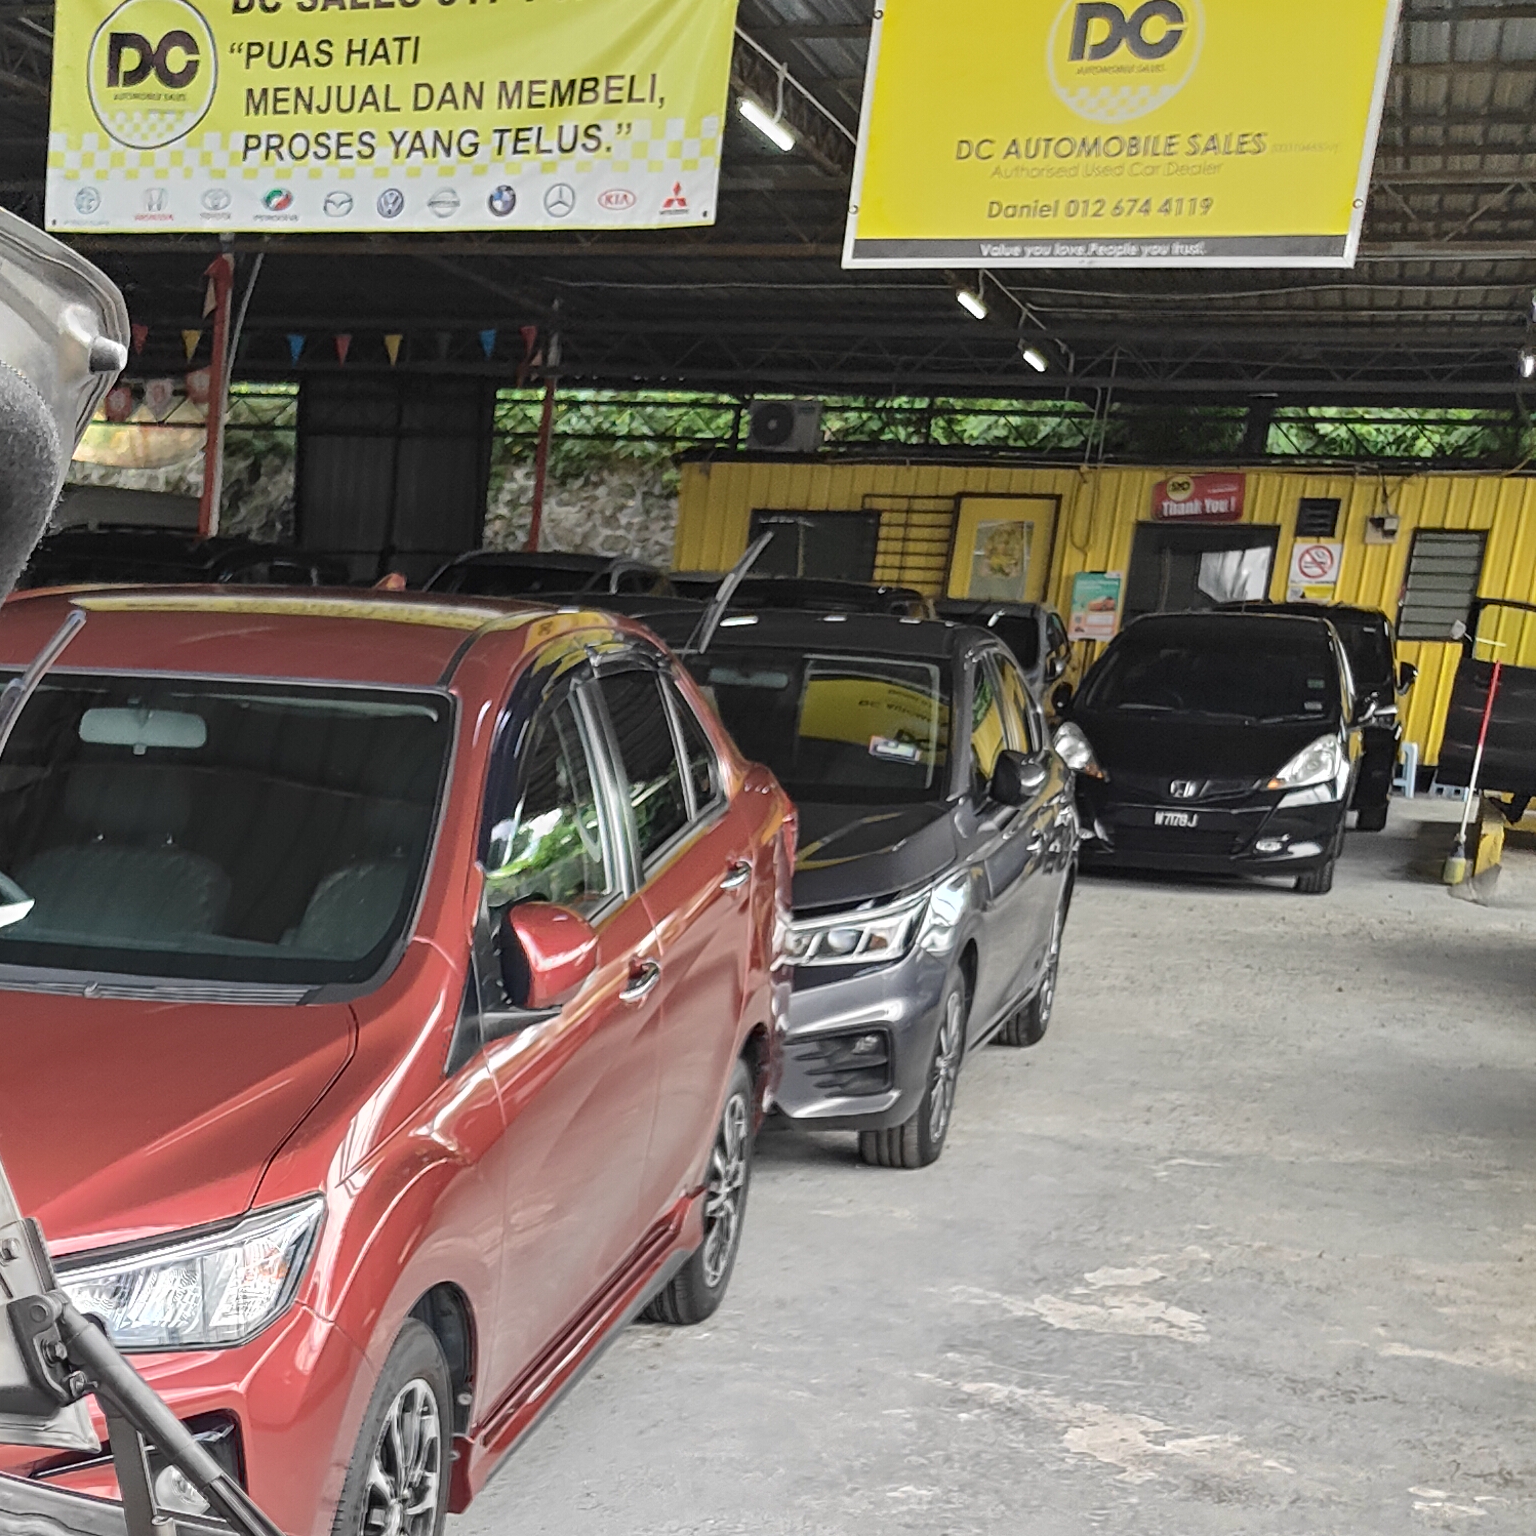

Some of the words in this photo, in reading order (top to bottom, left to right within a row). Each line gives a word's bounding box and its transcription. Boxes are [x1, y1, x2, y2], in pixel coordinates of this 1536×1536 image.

[1068, 0, 1184, 61] DC
[106, 30, 200, 88] DC
[346, 36, 420, 66] HATI
[244, 84, 401, 116] MENJUAL
[413, 81, 484, 111] DAN
[497, 73, 666, 110] MEMBELI,
[242, 131, 376, 162] PROSES
[388, 129, 481, 159] YANG
[956, 139, 995, 160] DC
[1002, 134, 1180, 160] AUTOMOBILE
[1184, 132, 1267, 156] SALES
[1082, 163, 1125, 177] Used
[1127, 162, 1160, 176] Car
[1163, 160, 1223, 175] Dealer
[605, 194, 630, 206] KIA
[987, 200, 1059, 219] Daniel
[1064, 199, 1107, 218] 012
[1110, 198, 1153, 217] 674
[1156, 196, 1214, 216] 4119
[1023, 245, 1052, 258] you
[1162, 499, 1202, 517] Thank
